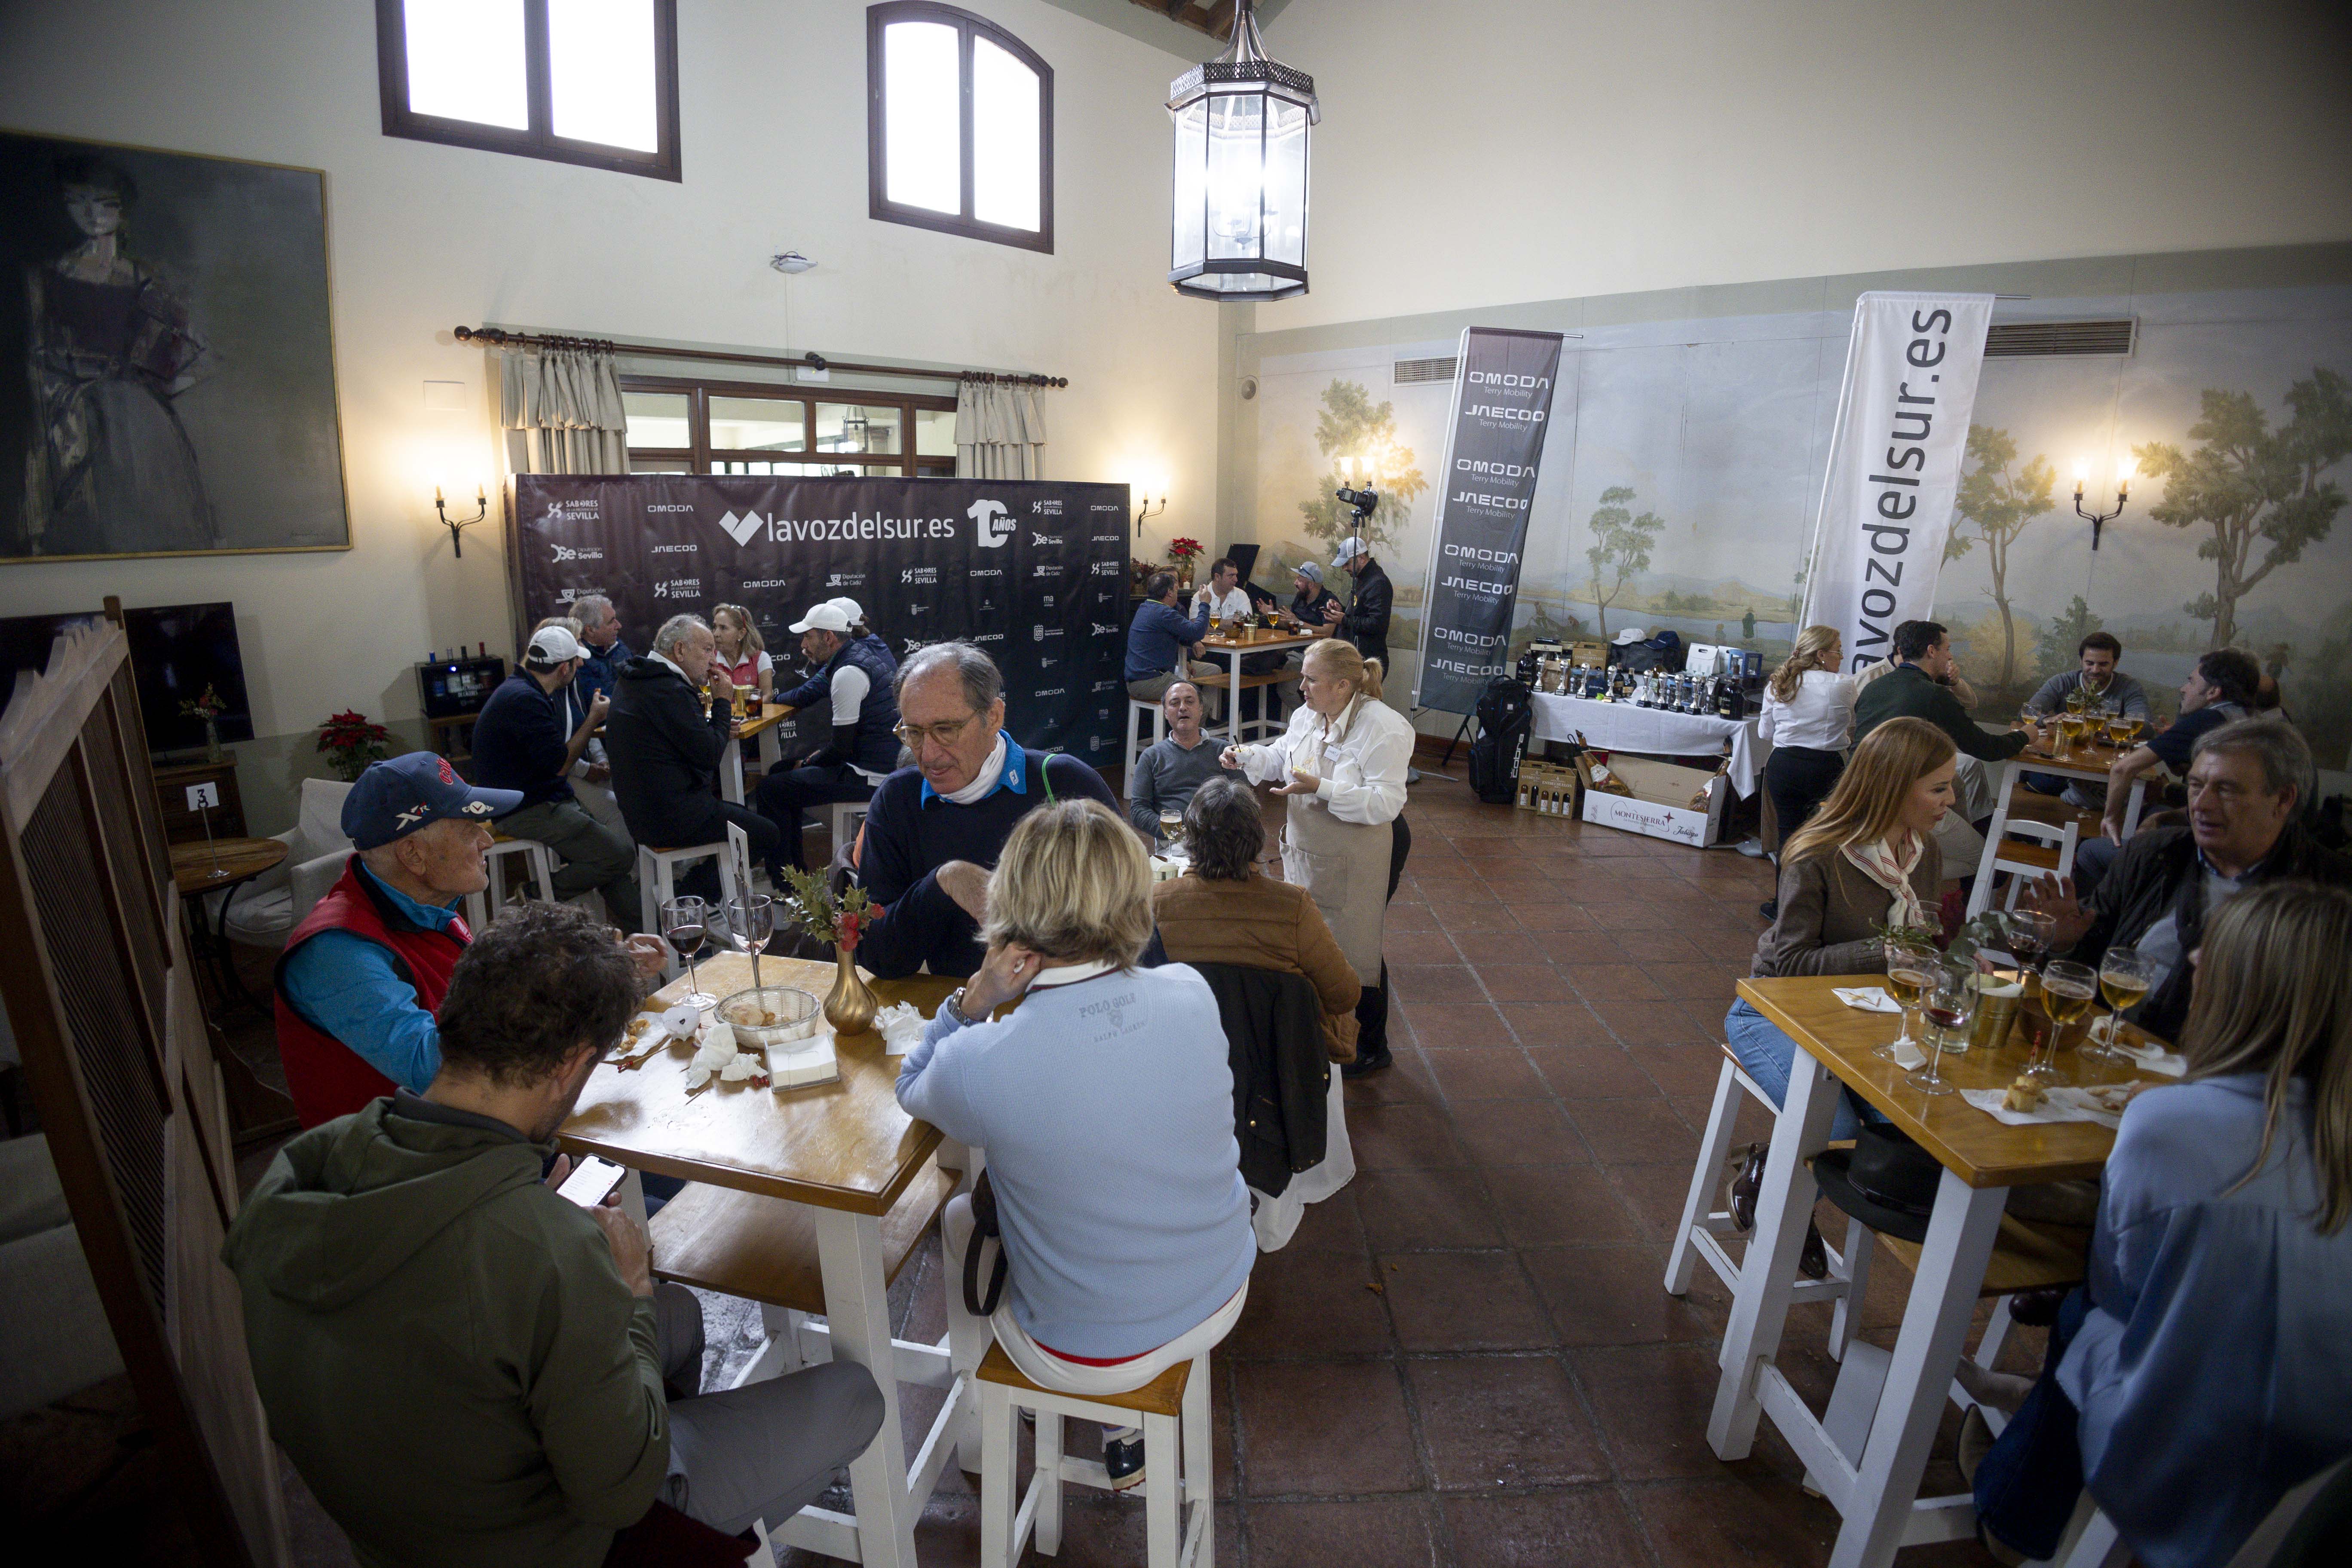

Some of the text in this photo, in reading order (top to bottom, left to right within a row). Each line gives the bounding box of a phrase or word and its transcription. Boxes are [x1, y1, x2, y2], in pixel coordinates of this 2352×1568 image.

[1470, 371, 1548, 389] OMODA
[1484, 386, 1532, 399] Terry Mobility
[1465, 404, 1545, 422] JAECOO
[1479, 419, 1527, 432] Terry Mobility
[1457, 459, 1535, 478] OMODA
[1471, 474, 1519, 487] Terry Mobility
[1852, 309, 1951, 674] avozdelsur.es
[1452, 492, 1528, 509] JAECOO
[1466, 506, 1515, 520] Terry Mobility
[768, 511, 955, 542] lavozdelsur.es
[992, 517, 1017, 531] AÑOS
[651, 545, 697, 553] JAECOO
[1445, 544, 1518, 564] OMODA
[1459, 560, 1505, 574] Terry Mobility
[743, 579, 786, 588] OMODA
[1441, 576, 1513, 595] JAECOO
[671, 590, 701, 598] SEVILLA
[1454, 591, 1499, 605] Terry Mobility
[1434, 627, 1506, 647] OMODA
[1447, 642, 1493, 657] Terry Mobility
[1430, 658, 1503, 676] JAECOO
[1443, 673, 1489, 685] Terry Mobility
[1035, 688, 1065, 697] OMODA
[1513, 734, 1524, 778] cobra
[197, 788, 207, 803] 3
[1614, 810, 1665, 826] MONTESIERRA
[1079, 992, 1136, 1018] POLO GOLF
